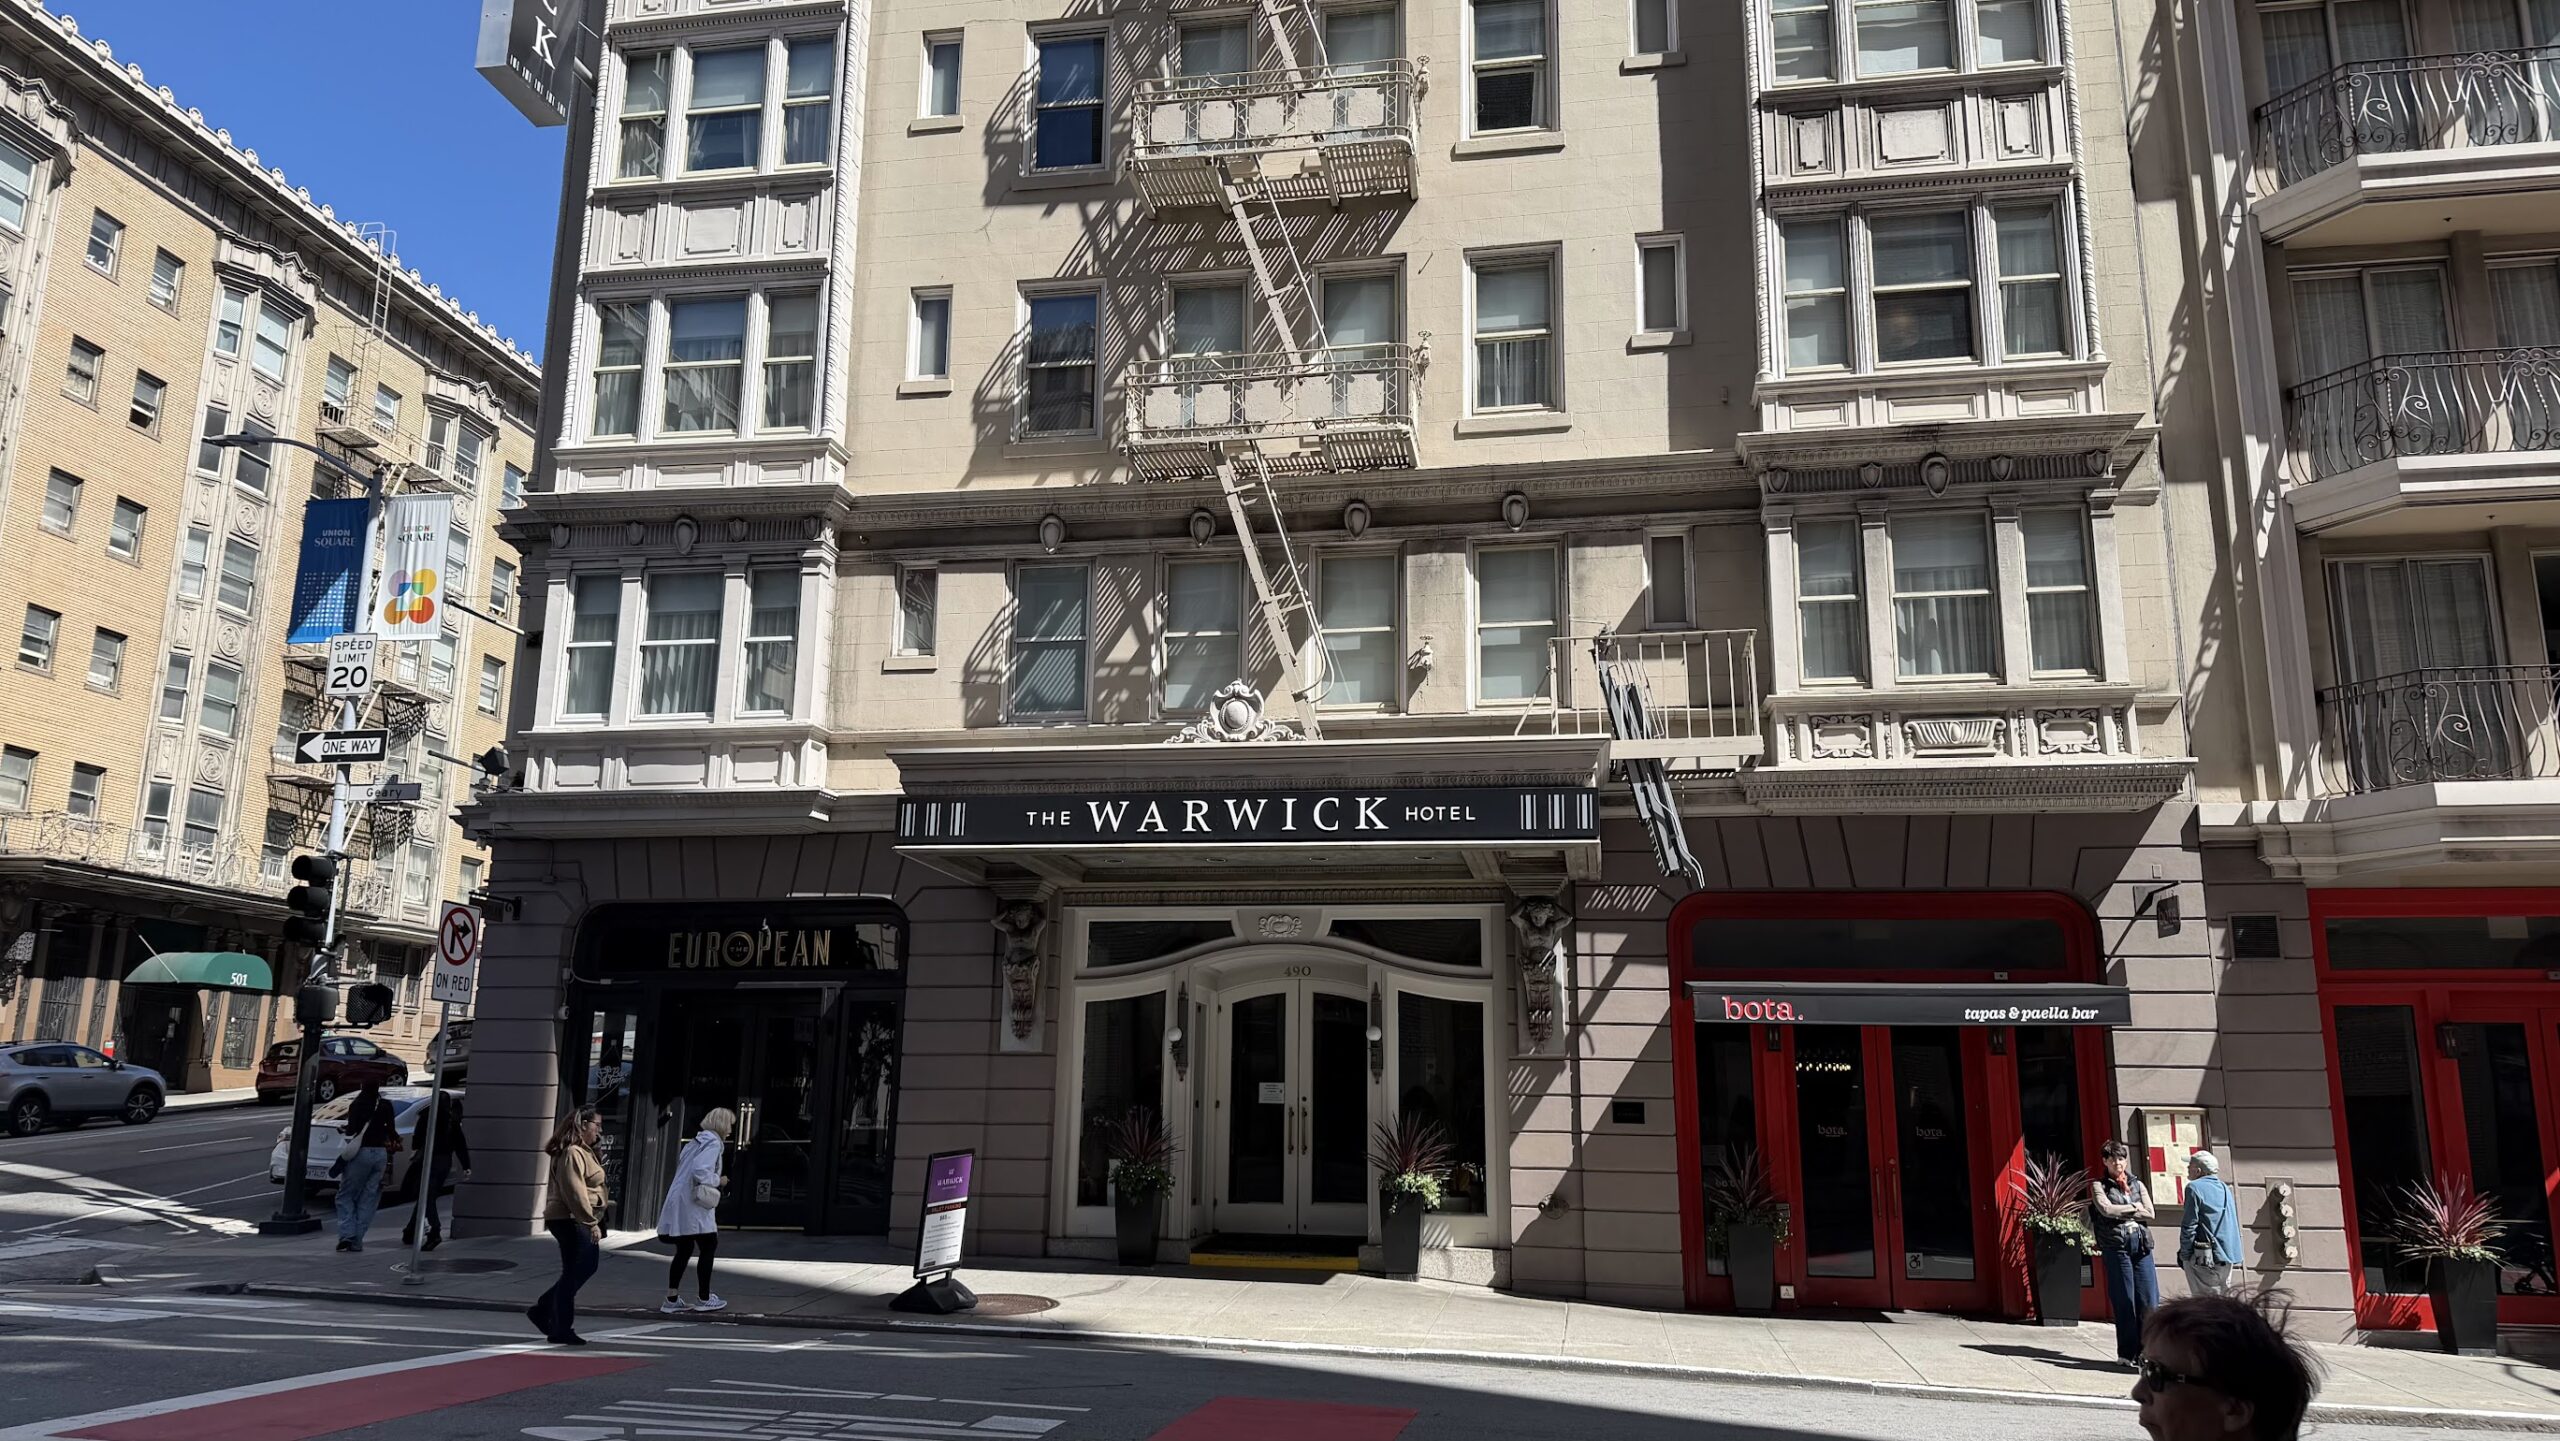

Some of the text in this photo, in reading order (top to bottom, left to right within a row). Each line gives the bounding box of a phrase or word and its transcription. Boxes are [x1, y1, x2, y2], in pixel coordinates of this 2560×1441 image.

[322, 529, 351, 537] UNION
[403, 525, 430, 533] UNION
[314, 536, 357, 547] SQUARE
[397, 532, 436, 543] SQUARE
[334, 640, 373, 651] SPEED
[337, 652, 368, 663] LIMIT
[331, 665, 368, 688] 20
[322, 739, 377, 754] ONE WAY
[366, 787, 402, 799] Geary
[1026, 796, 1476, 833] THE WARWICK HOTEL
[668, 929, 831, 969] EUROPEAN
[1283, 965, 1312, 977] 490
[229, 972, 248, 986] 501
[435, 972, 470, 992] ON RED
[1721, 995, 1805, 1021] bota.
[1964, 1006, 2099, 1023] tapas & paella bar
